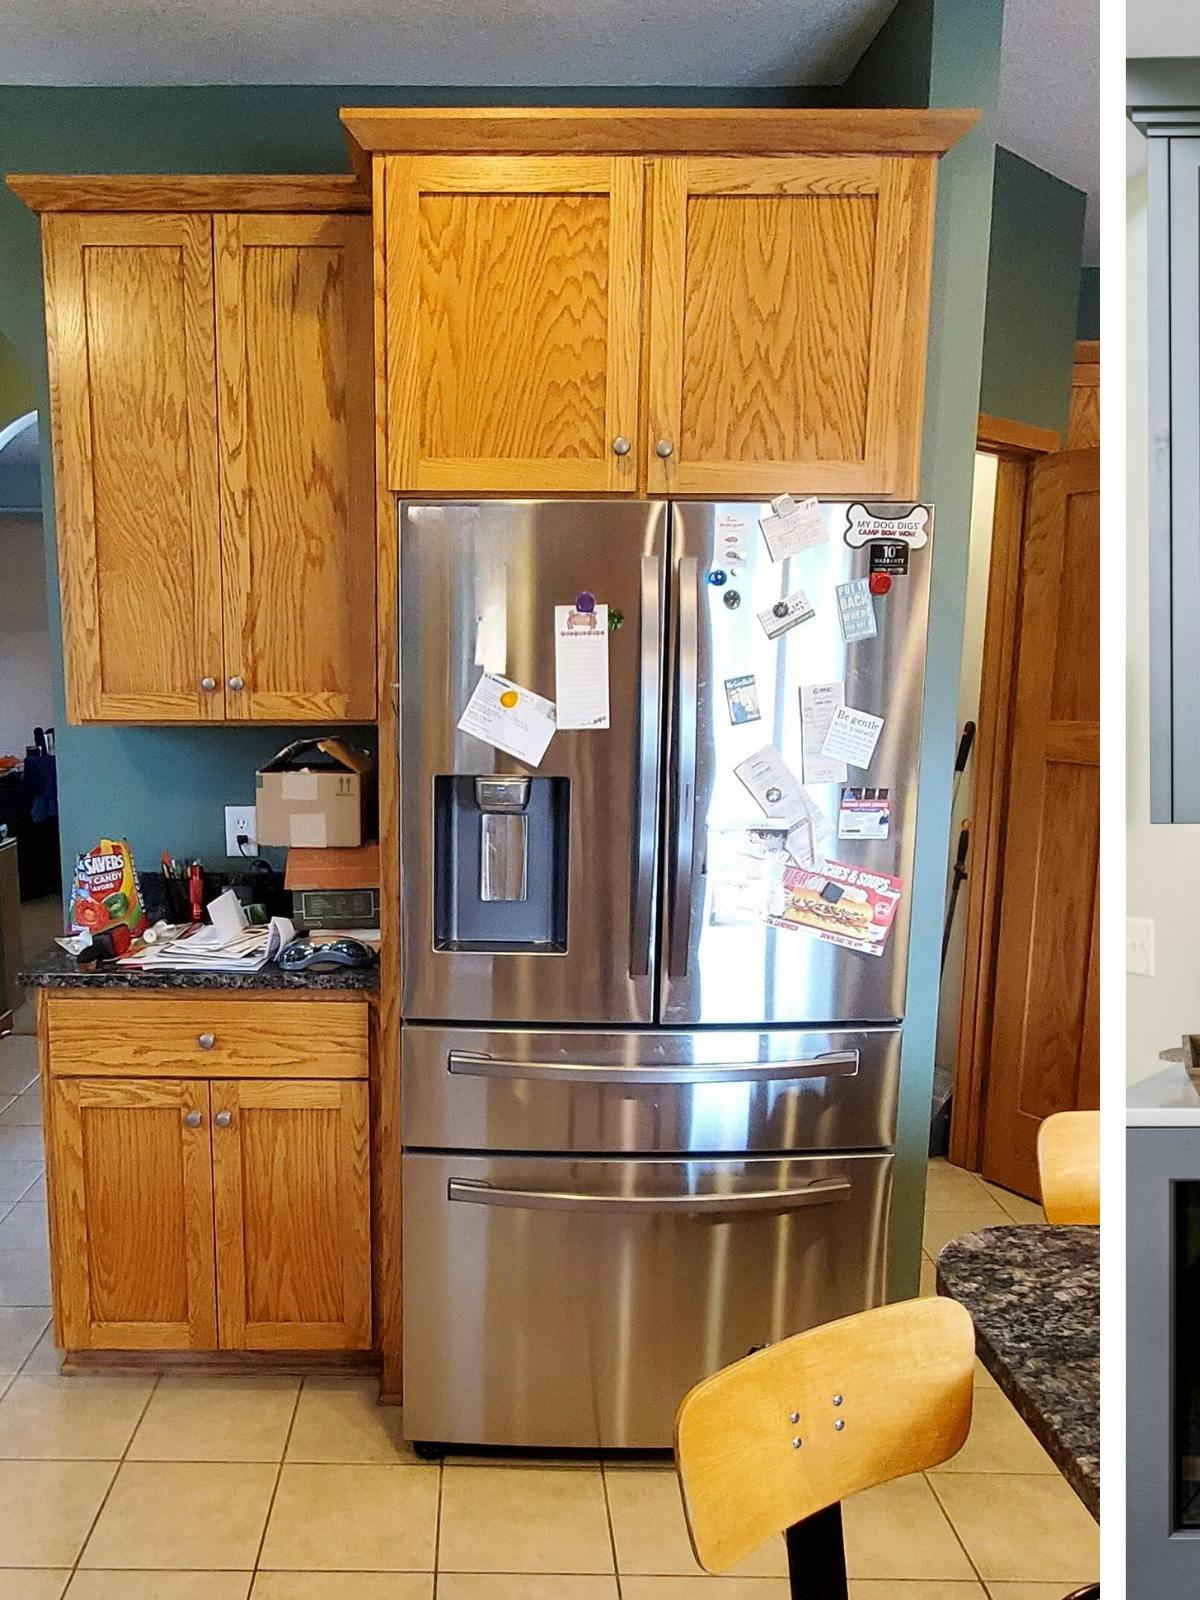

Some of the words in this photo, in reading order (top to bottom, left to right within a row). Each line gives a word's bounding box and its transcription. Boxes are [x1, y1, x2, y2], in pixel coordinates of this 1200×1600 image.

[857, 520, 871, 529] MY
[873, 521, 895, 529] DOG
[897, 522, 920, 530] DIGS
[858, 528, 880, 536] CAMP
[881, 529, 897, 537] BOW
[883, 545, 896, 558] 10
[838, 582, 856, 596] PUT
[837, 709, 850, 721] Be
[850, 716, 880, 731] gentle
[84, 854, 124, 875] SAVERS
[93, 871, 122, 885] CANDY
[859, 872, 891, 892] SOUPS
